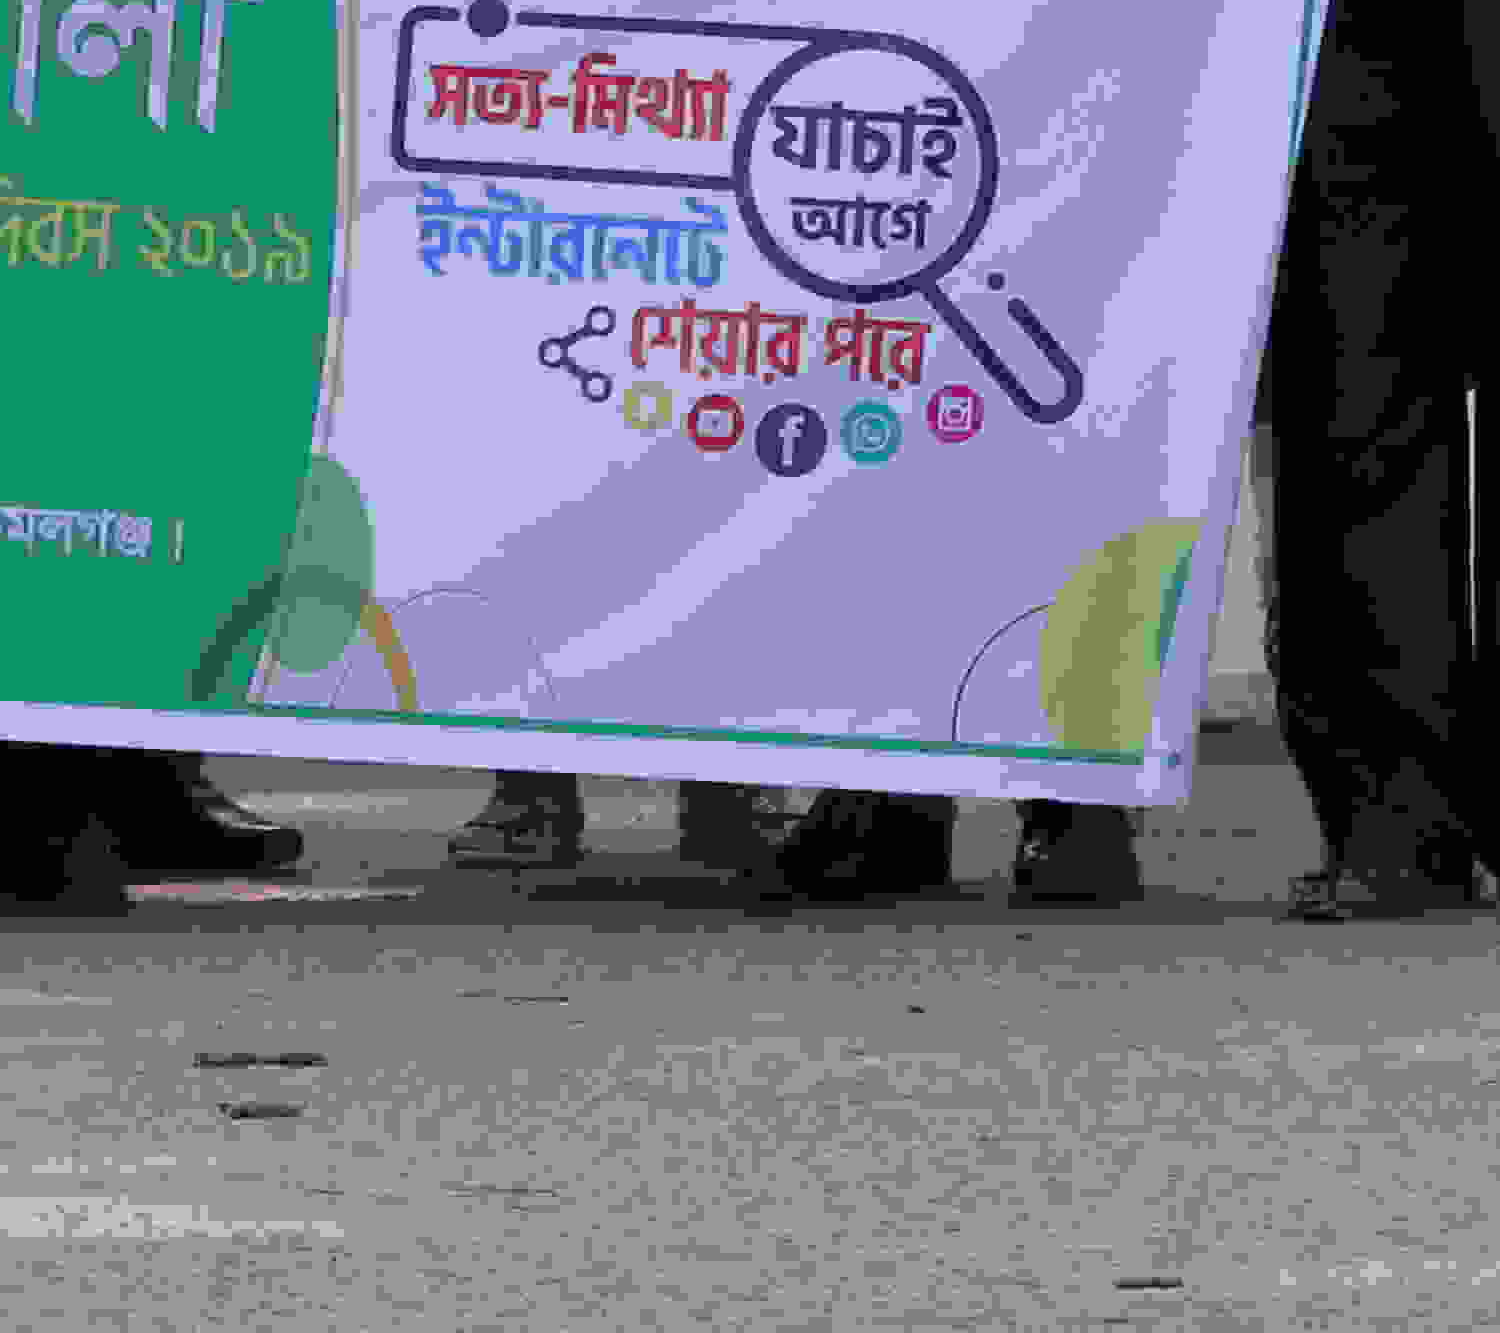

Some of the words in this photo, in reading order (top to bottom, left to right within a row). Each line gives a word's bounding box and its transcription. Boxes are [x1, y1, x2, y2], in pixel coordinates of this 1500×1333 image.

[424, 52, 730, 142] সত্য-মিথ্যা
[770, 98, 965, 180] যাচাই
[137, 205, 313, 285] ২০১৯
[788, 196, 934, 250] আগে
[629, 299, 808, 382] শেয়ার
[823, 308, 932, 390] পরে
